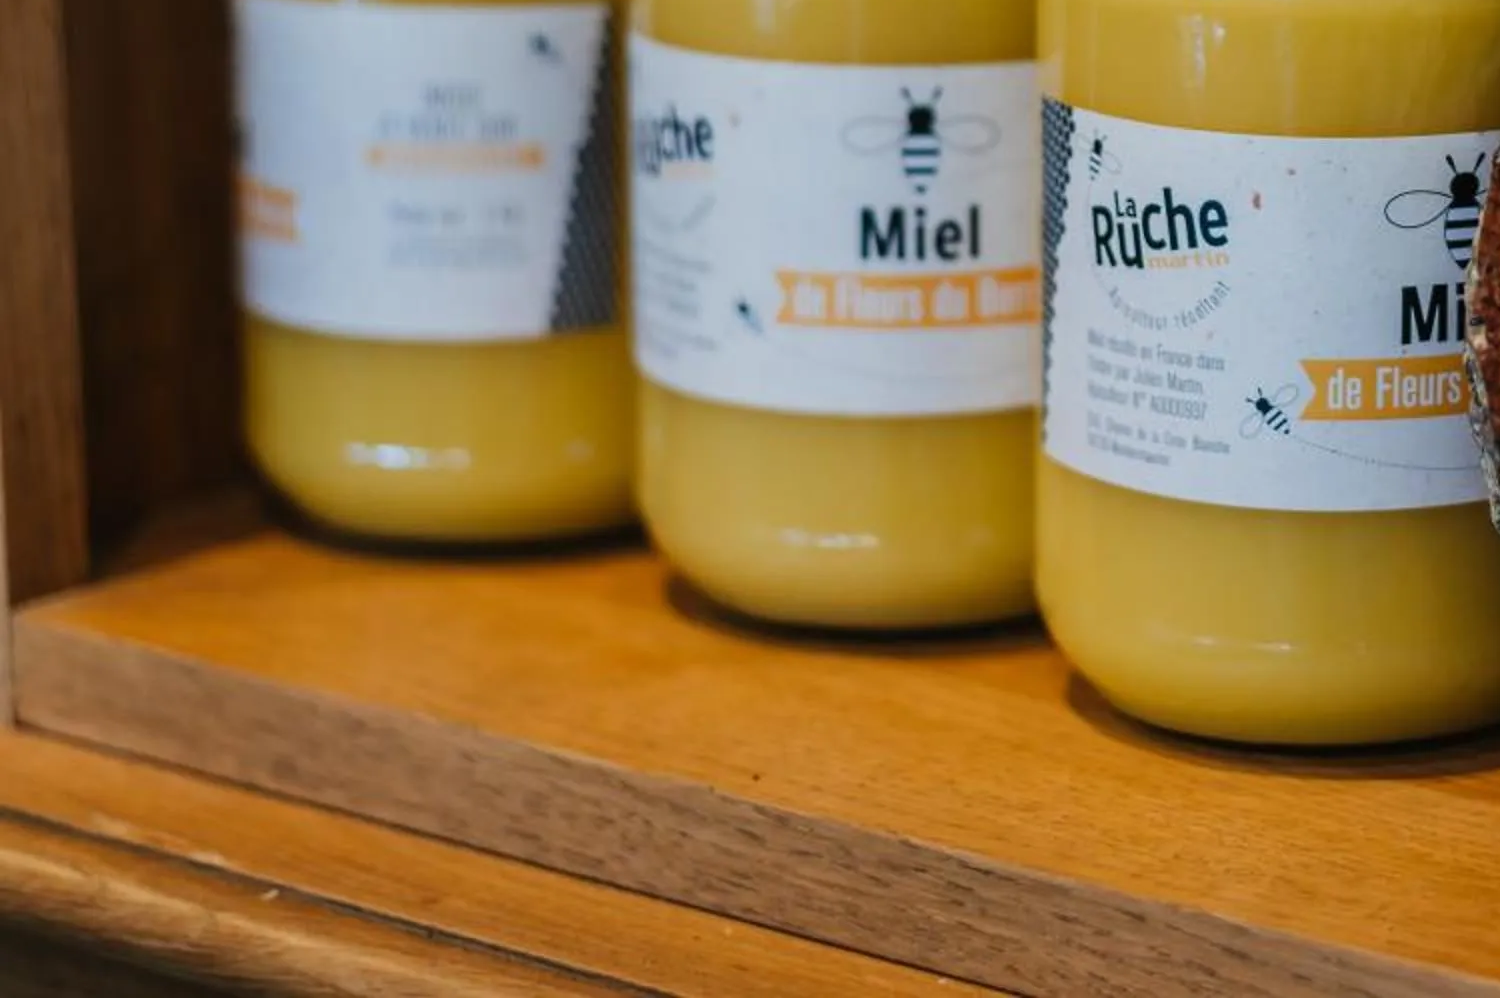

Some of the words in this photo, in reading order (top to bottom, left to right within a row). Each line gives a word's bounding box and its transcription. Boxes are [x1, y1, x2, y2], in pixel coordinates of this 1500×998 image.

[1092, 187, 1229, 270] Ruche
[1113, 189, 1137, 218] La
[860, 204, 980, 261] Miel
[1401, 281, 1466, 345] Mi
[1328, 367, 1362, 410] de
[1376, 366, 1462, 410] Fleurs
